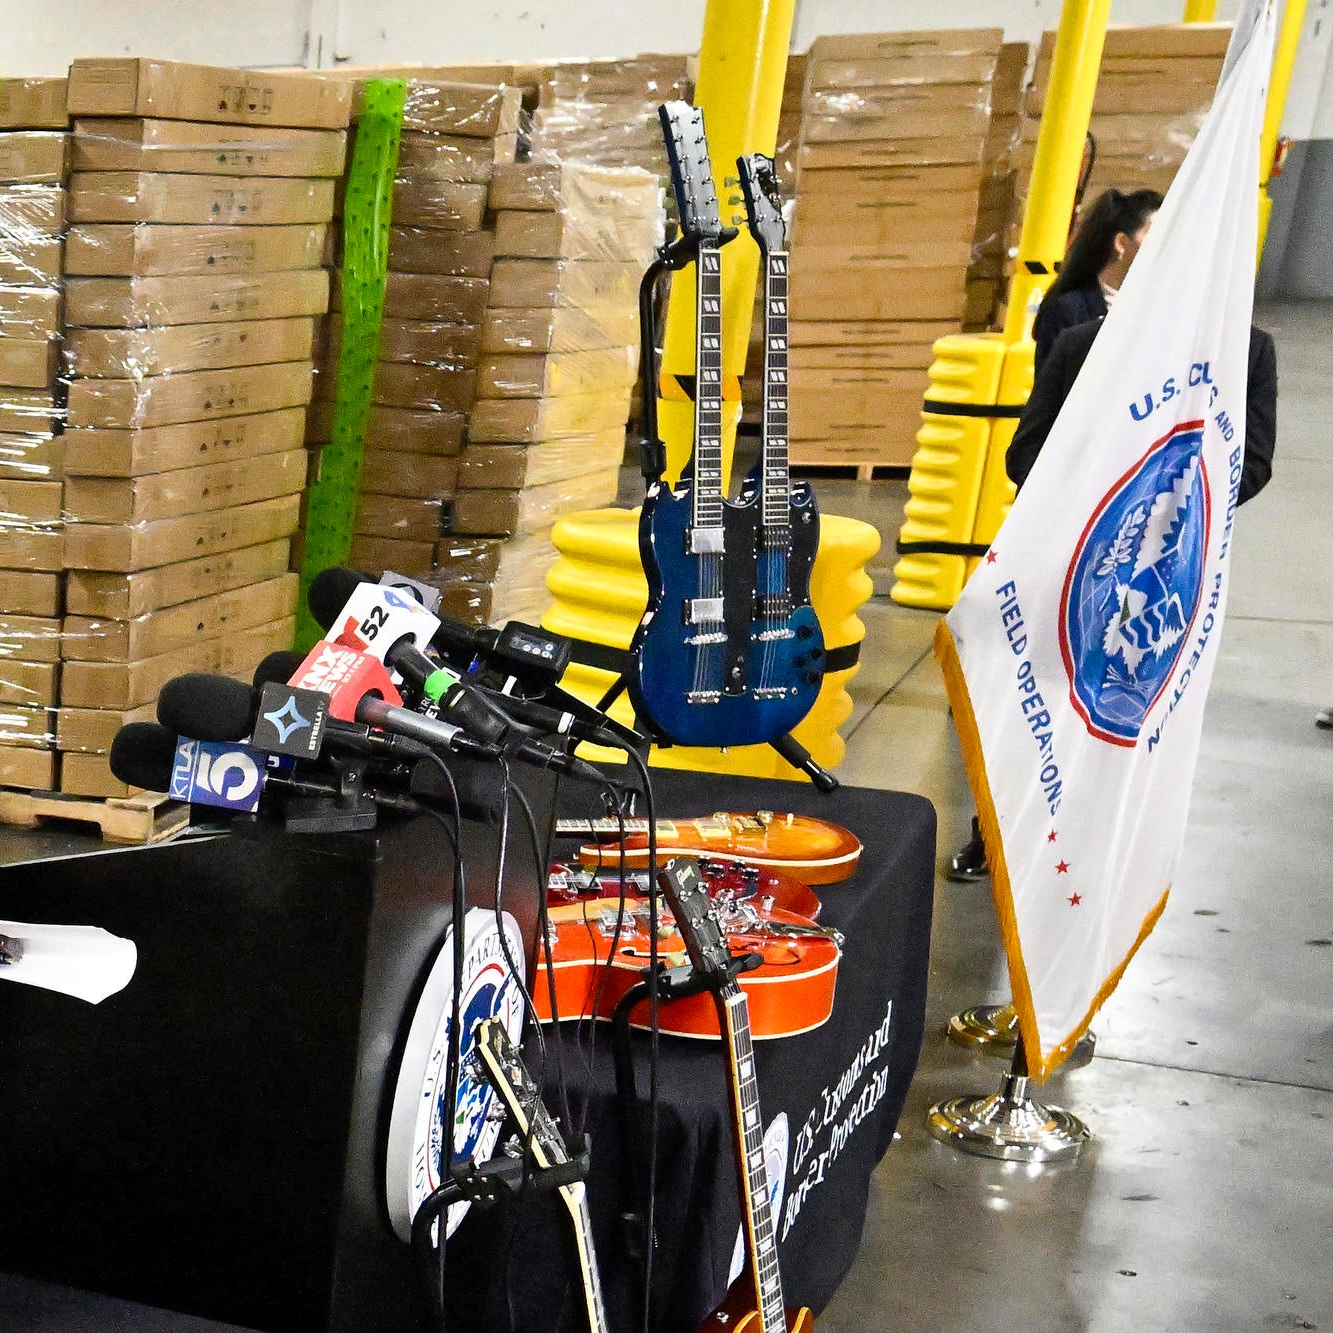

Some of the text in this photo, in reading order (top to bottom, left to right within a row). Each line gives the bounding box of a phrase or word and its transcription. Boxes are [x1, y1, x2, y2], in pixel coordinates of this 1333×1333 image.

[1129, 377, 1182, 422] U.S.
[1214, 410, 1235, 442] AND
[360, 605, 390, 642] 52
[317, 651, 358, 694] EWS
[995, 580, 1064, 817] FIELD OPERATIONS
[170, 741, 196, 799] KTLA
[196, 751, 259, 801] 5
